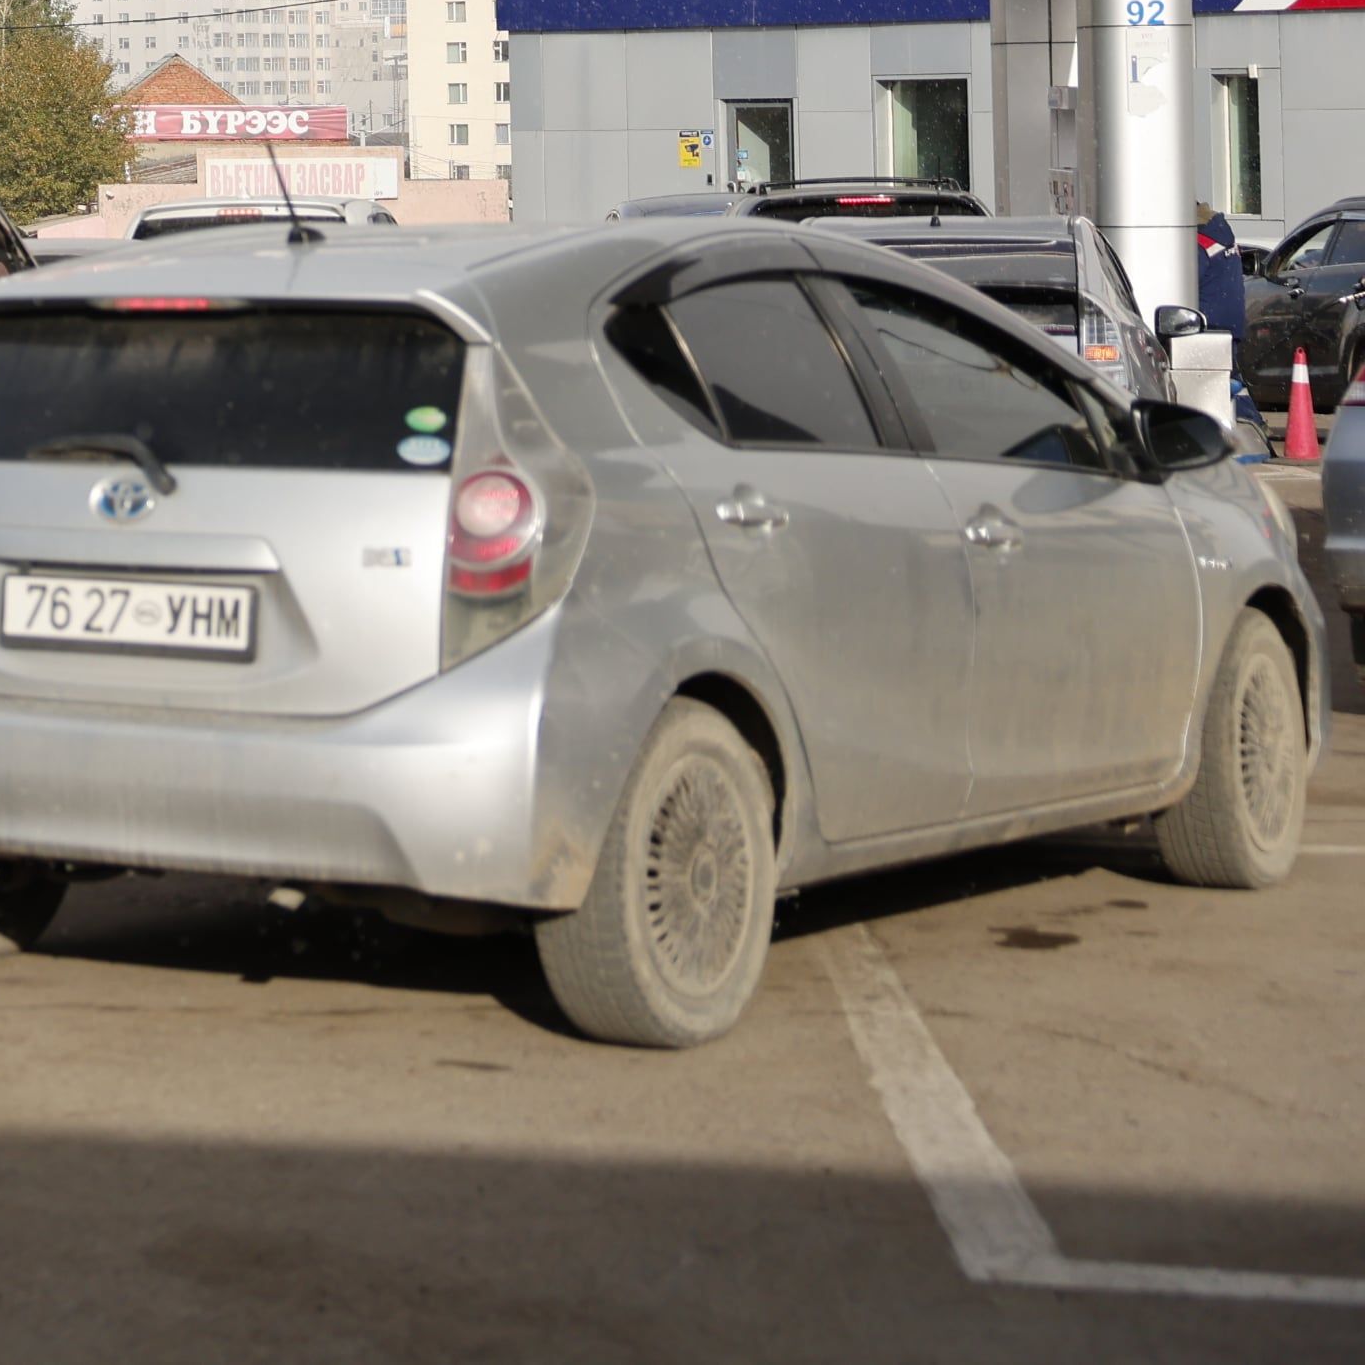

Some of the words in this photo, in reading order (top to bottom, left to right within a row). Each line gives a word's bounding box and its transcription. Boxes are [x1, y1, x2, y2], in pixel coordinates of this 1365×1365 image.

[1126, 0, 1166, 26] 92
[180, 110, 310, 135] БҮРЭЭС
[296, 163, 366, 195] ЗАСВАР
[167, 594, 240, 639] УНМ
